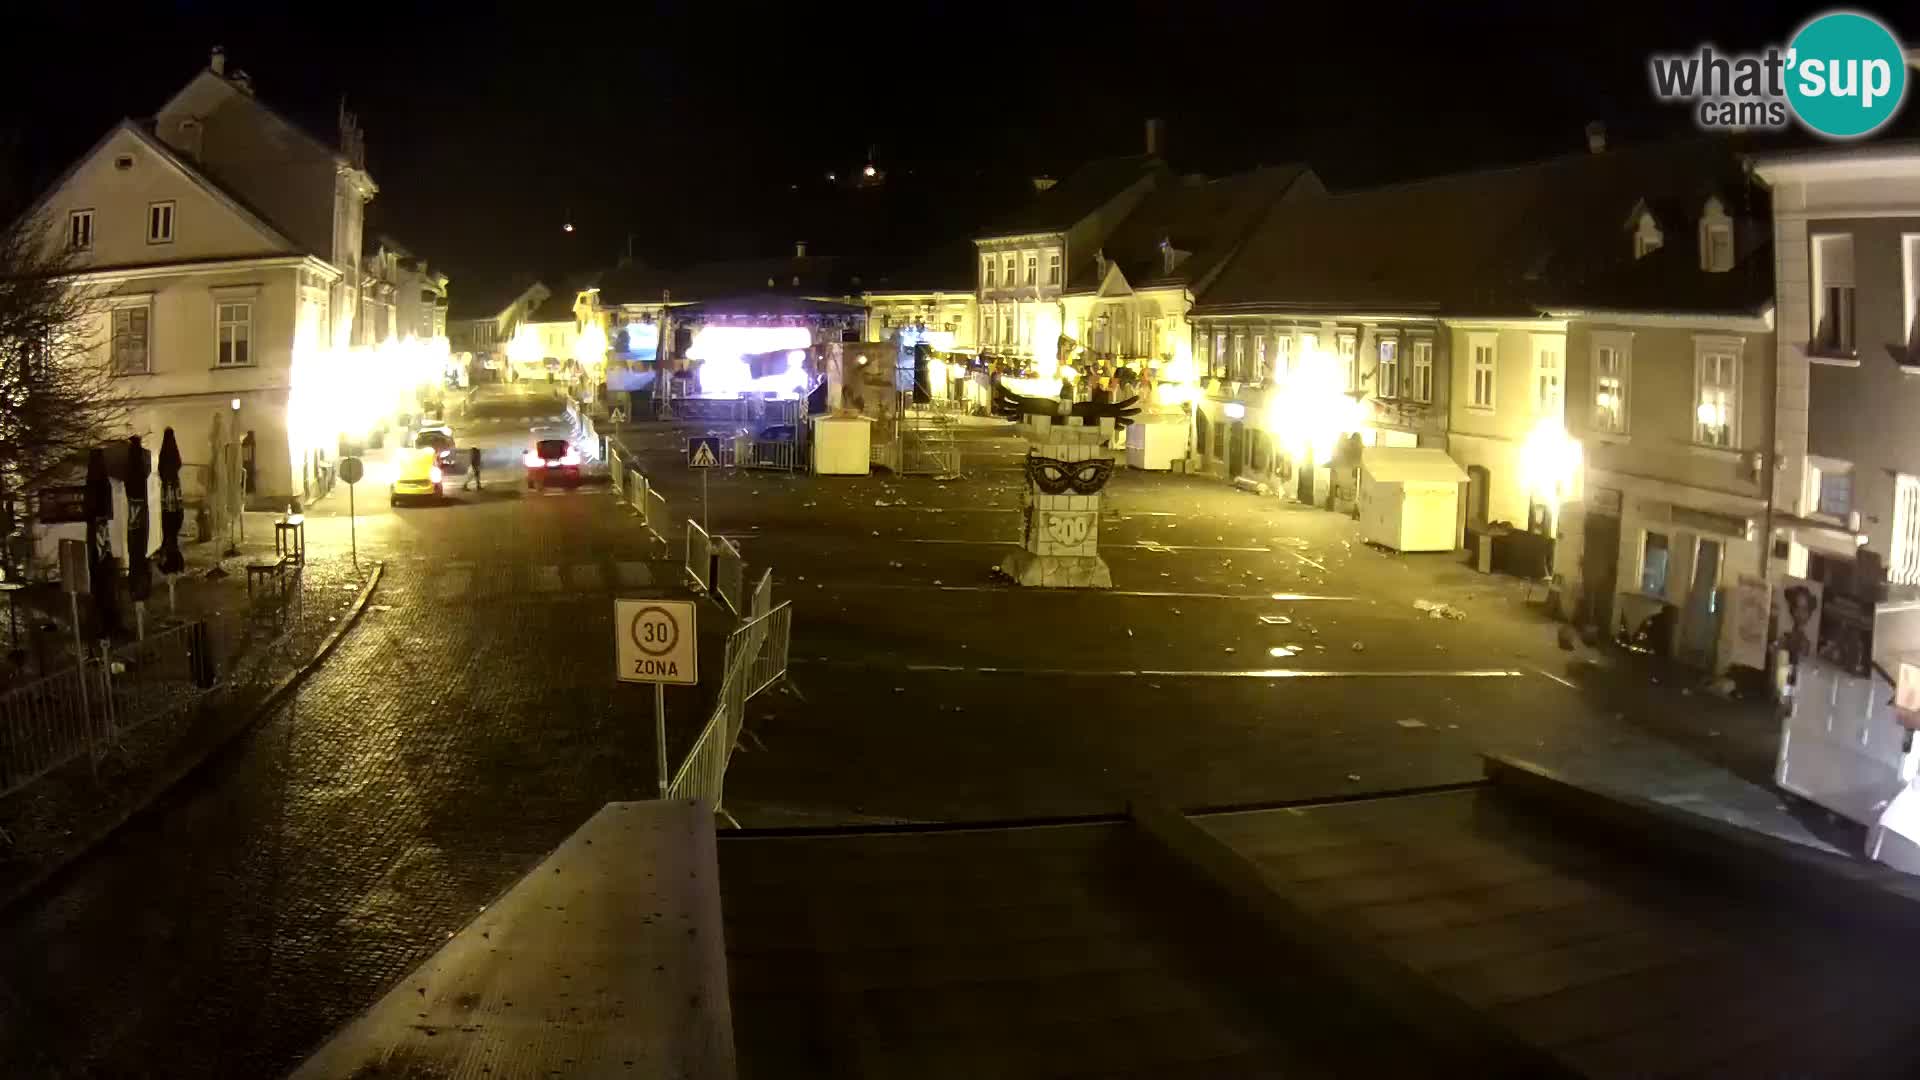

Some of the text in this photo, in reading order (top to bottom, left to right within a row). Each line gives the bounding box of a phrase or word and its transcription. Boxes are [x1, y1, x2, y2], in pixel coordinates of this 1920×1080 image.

[1049, 516, 1087, 545] 200
[643, 622, 667, 642] 30
[634, 660, 678, 676] ZONA
